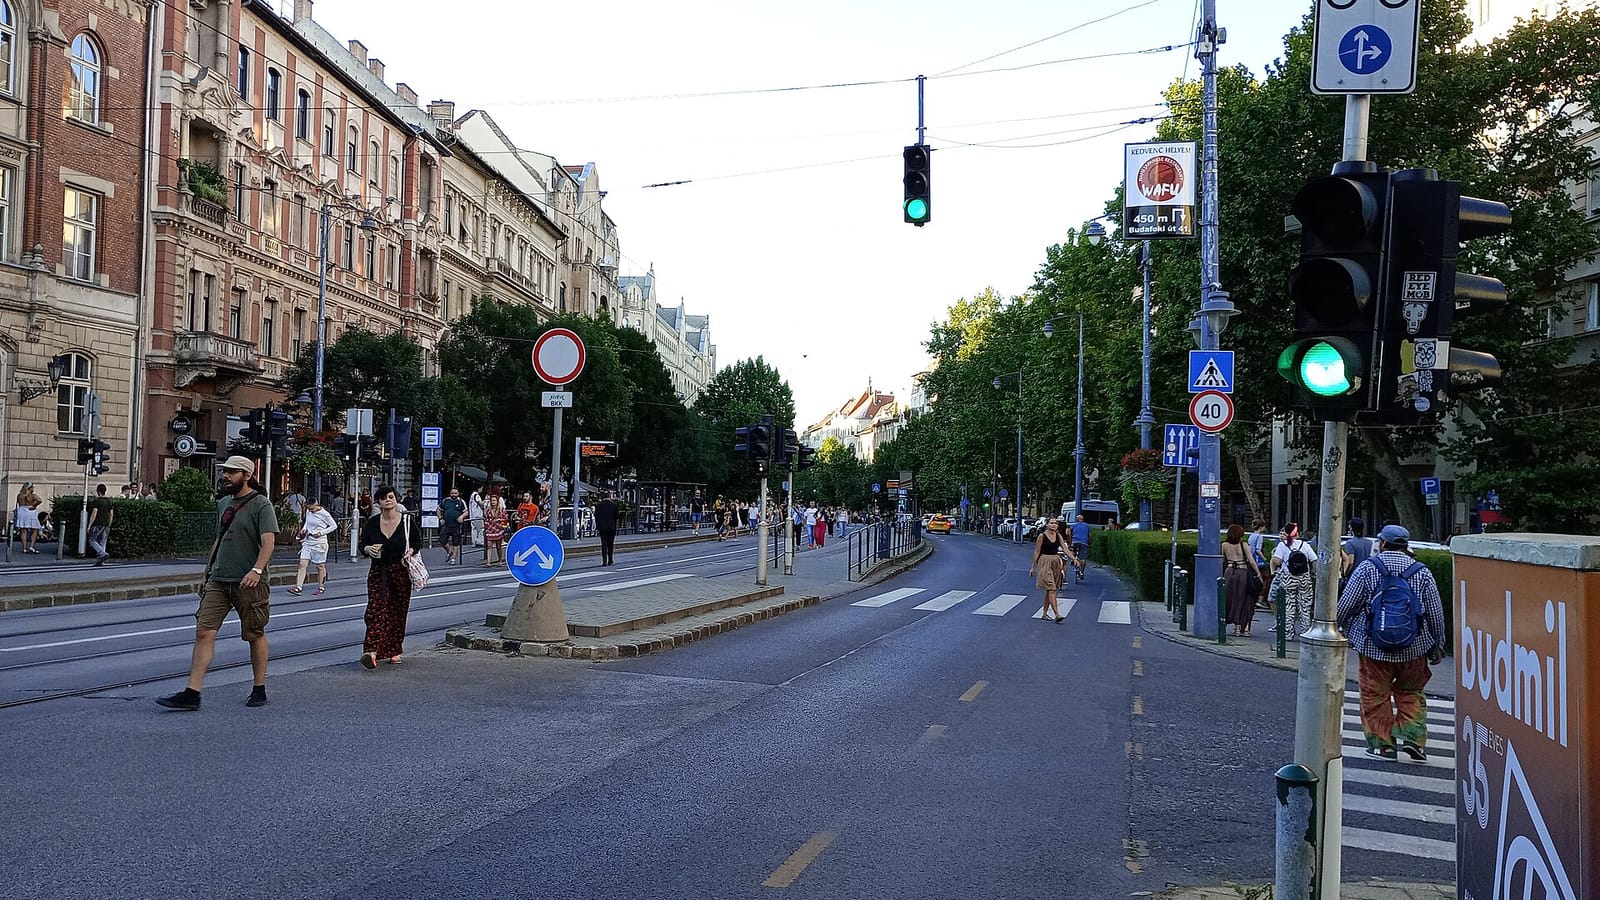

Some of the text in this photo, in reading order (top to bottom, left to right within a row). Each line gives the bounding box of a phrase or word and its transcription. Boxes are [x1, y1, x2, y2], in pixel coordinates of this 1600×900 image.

[1165, 146, 1192, 154] HELYEM
[1142, 183, 1180, 196] WAFU
[1133, 214, 1168, 223] 450 m
[1129, 225, 1165, 233] Budafoki
[1408, 282, 1430, 290] EYE
[1407, 290, 1430, 298] MOB
[1200, 403, 1221, 419] 40
[1424, 480, 1436, 492] P
[1460, 579, 1568, 747] budmil
[1462, 715, 1504, 830] 35 ÉVES
